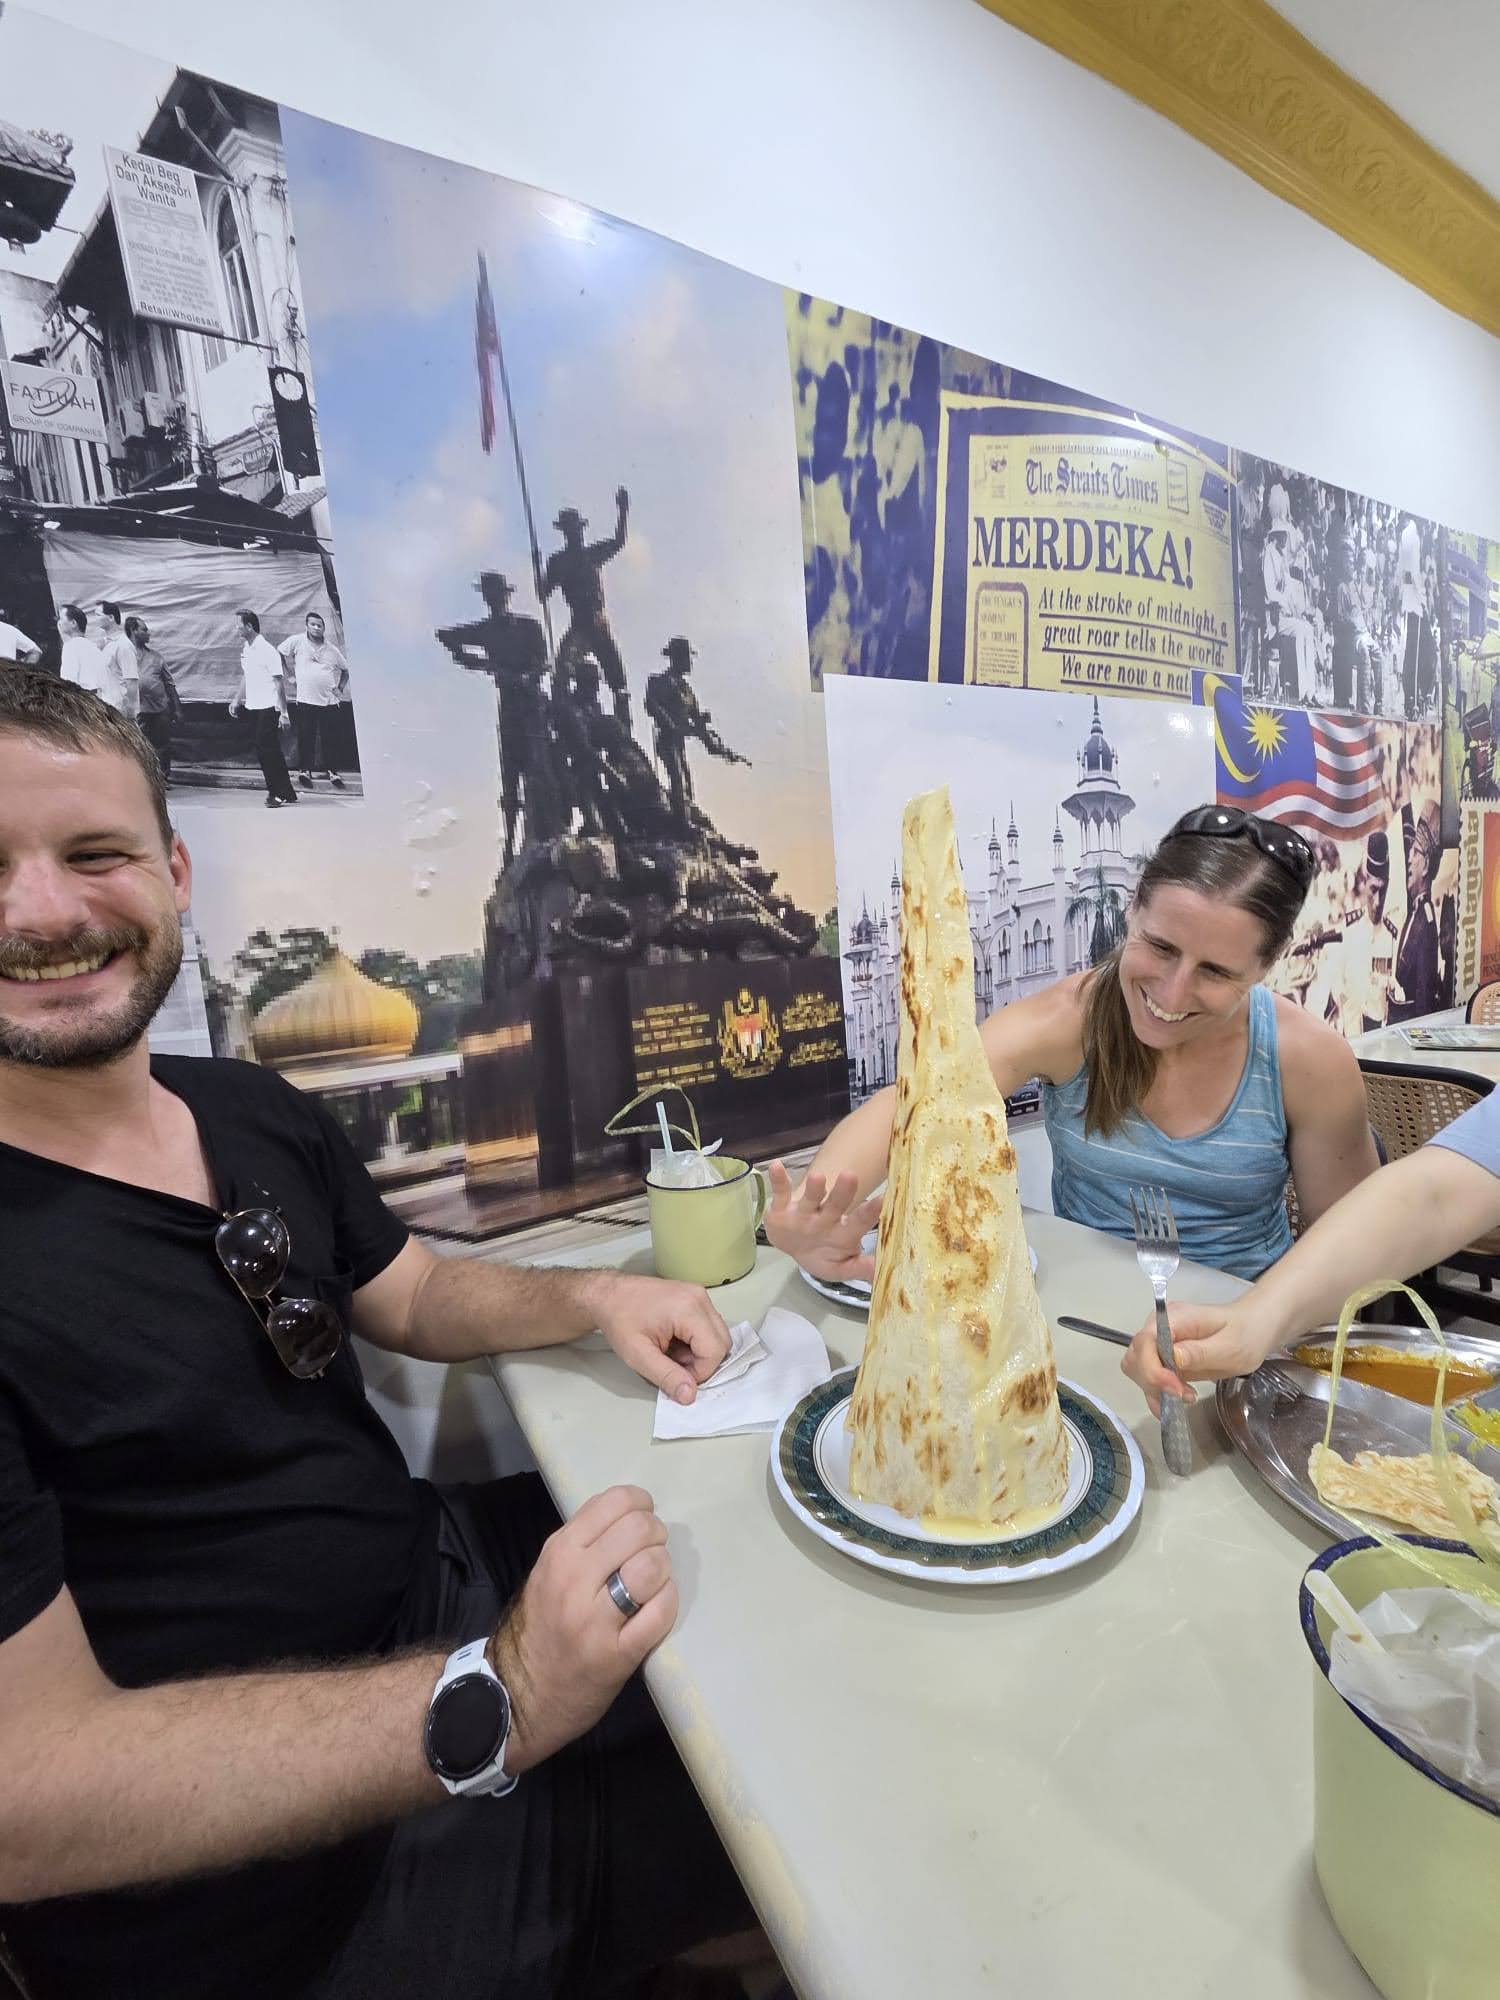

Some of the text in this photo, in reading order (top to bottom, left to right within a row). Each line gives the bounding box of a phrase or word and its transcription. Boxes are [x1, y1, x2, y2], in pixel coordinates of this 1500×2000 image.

[115, 166, 192, 199] Dan Aksesori
[122, 154, 180, 184] Kedai Beg
[137, 186, 177, 208] Wanita
[13, 414, 42, 426] GROUP
[1025, 458, 1053, 495] The
[1056, 457, 1109, 496] Straits
[1111, 462, 1158, 505] Times
[972, 516, 1193, 589] MERDEKA!
[1039, 588, 1228, 638] At the stroke of midnight, a
[1044, 622, 1225, 669] great roar tells the world:
[1061, 655, 1082, 678] We
[1086, 662, 1111, 681] are
[1116, 665, 1148, 686] now
[1152, 670, 1162, 688] a
[1462, 810, 1482, 988] malaysia
